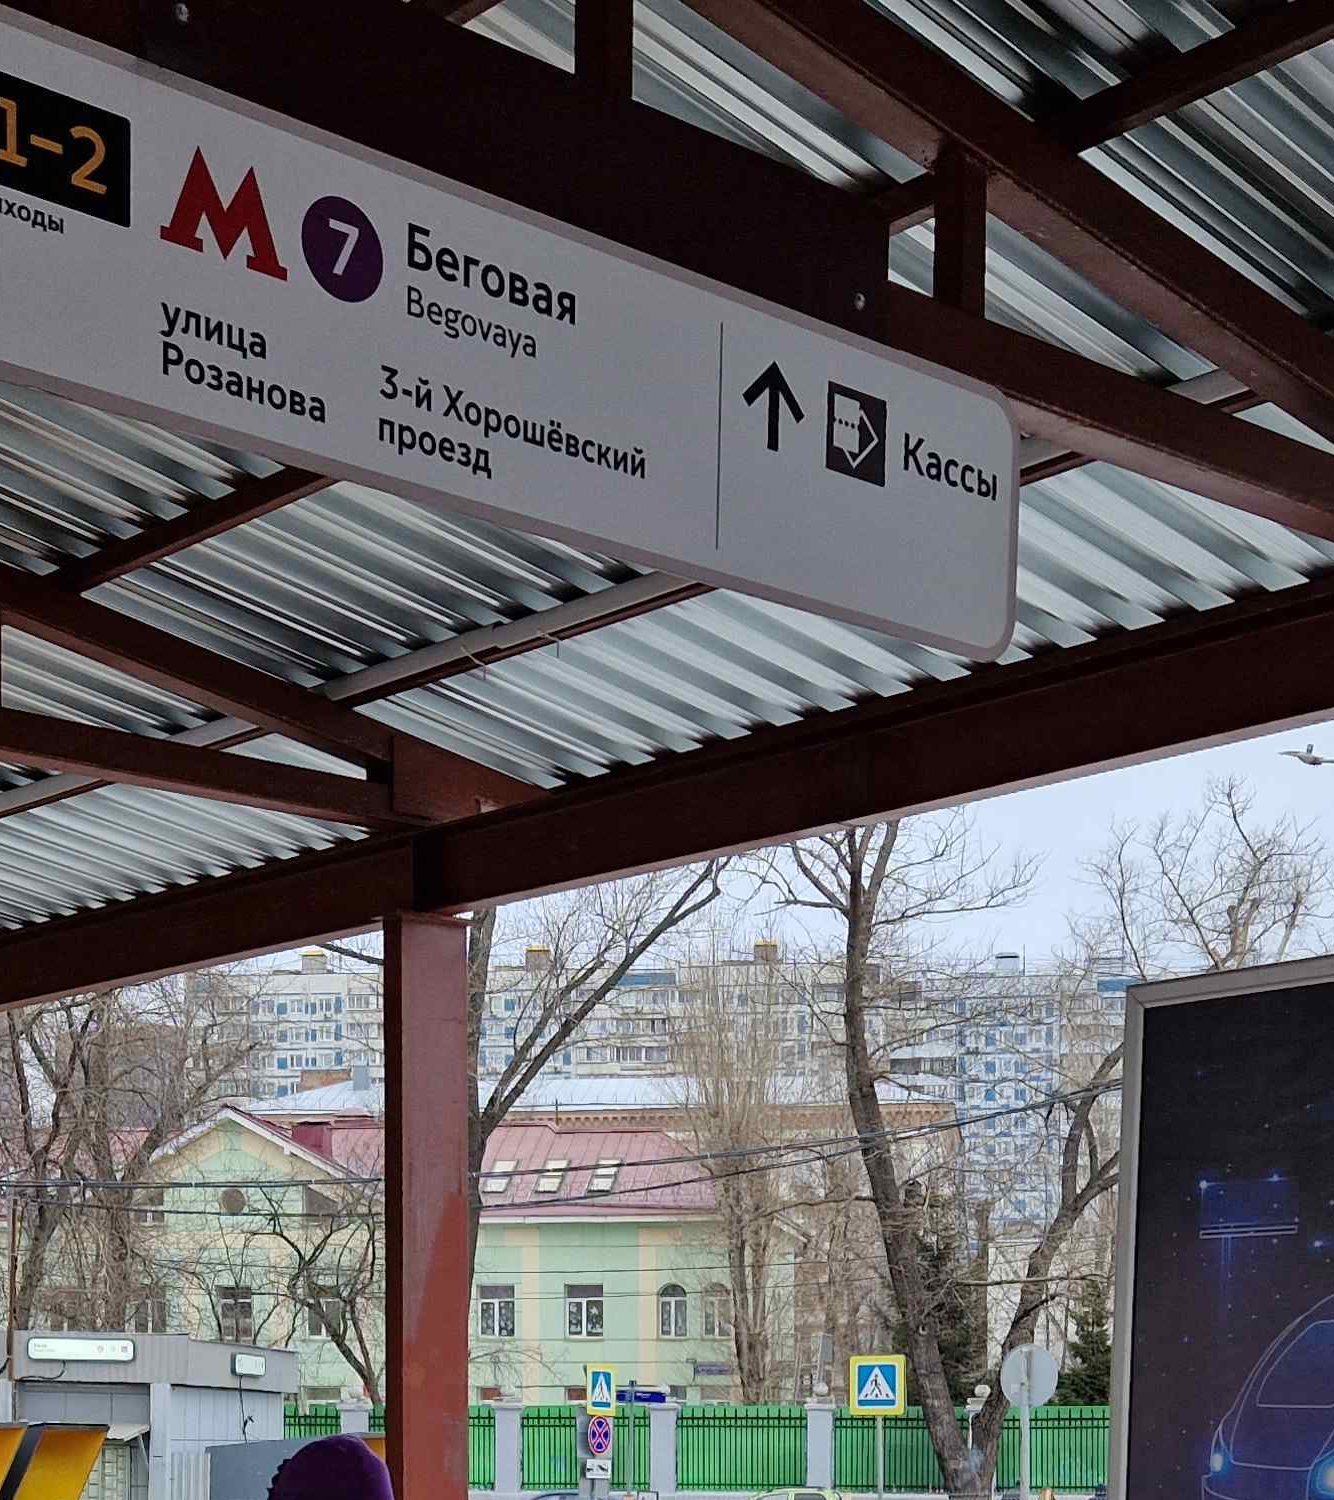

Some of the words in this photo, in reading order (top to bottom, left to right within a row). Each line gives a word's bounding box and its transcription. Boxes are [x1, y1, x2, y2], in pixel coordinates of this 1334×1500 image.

[327, 217, 360, 277] 7
[407, 222, 577, 326] Беговая
[159, 301, 267, 361] улица
[407, 285, 537, 358] Begovaya
[162, 340, 326, 424] Розанова
[378, 417, 492, 480] проезд
[379, 364, 433, 412] 3-й
[442, 384, 647, 480] Хорошёвский
[903, 432, 997, 501] Кассы
